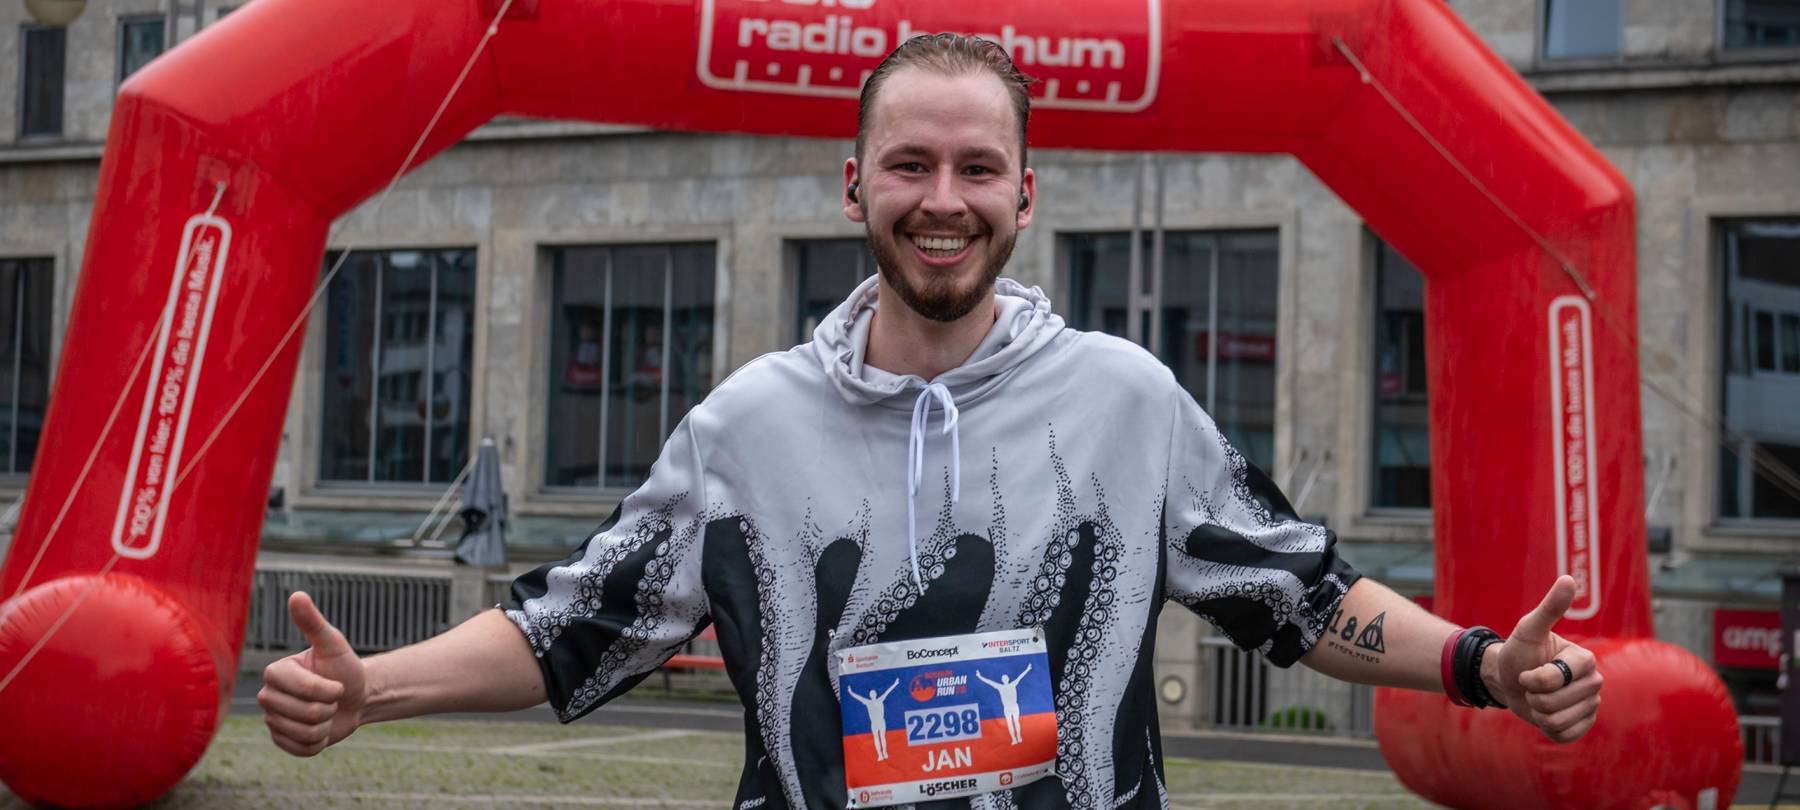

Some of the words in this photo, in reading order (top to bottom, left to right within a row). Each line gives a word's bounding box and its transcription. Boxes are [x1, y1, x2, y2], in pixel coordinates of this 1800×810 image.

[738, 14, 887, 57] radio
[897, 20, 1125, 69] hum
[176, 290, 202, 339] beste
[172, 338, 190, 366] die
[158, 367, 184, 416] 100%
[146, 454, 163, 485] von
[130, 487, 157, 536] 100%
[907, 645, 959, 660] BoConcept
[988, 638, 1030, 647] INTERSPORT
[936, 675, 967, 687] URBAN
[936, 686, 955, 697] RUN
[908, 709, 979, 742] 2298
[922, 746, 972, 772] JAN
[919, 778, 977, 796] LÖSCHER
